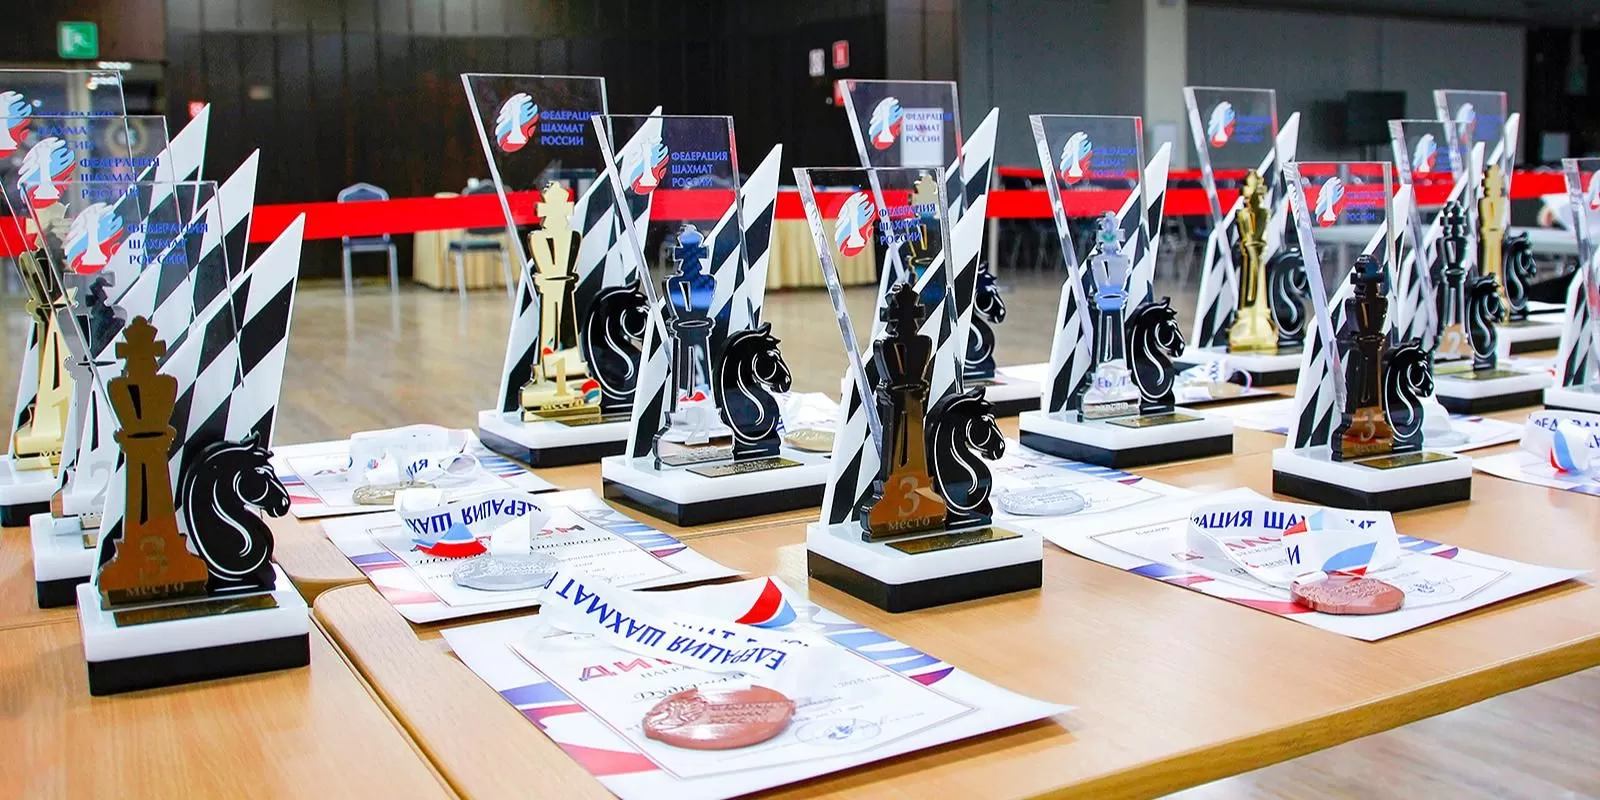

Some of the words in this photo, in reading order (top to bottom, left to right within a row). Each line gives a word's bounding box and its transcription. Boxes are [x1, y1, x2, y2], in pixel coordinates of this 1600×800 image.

[541, 123, 584, 132] ШАХМАТ
[541, 135, 584, 145] РОССИИ
[671, 151, 728, 161] ФЕДЕРАЦИЯ
[671, 164, 713, 174] ШАХМАТ
[671, 177, 713, 187] РОССИИ
[127, 223, 209, 233] ФЕДЕРАЦИЯ
[128, 239, 188, 249] ШАХМАТ
[880, 231, 921, 246] РОССИИ
[128, 255, 188, 265] РОССИИ
[551, 357, 571, 397] 1
[1360, 409, 1376, 442] 3
[898, 476, 920, 517] 3
[404, 512, 453, 534] ШАХ
[888, 516, 931, 531] место
[139, 535, 169, 583] 3
[556, 578, 667, 648] ШАХМАТ
[666, 635, 788, 671] ЕДЕРАЦИЯ
